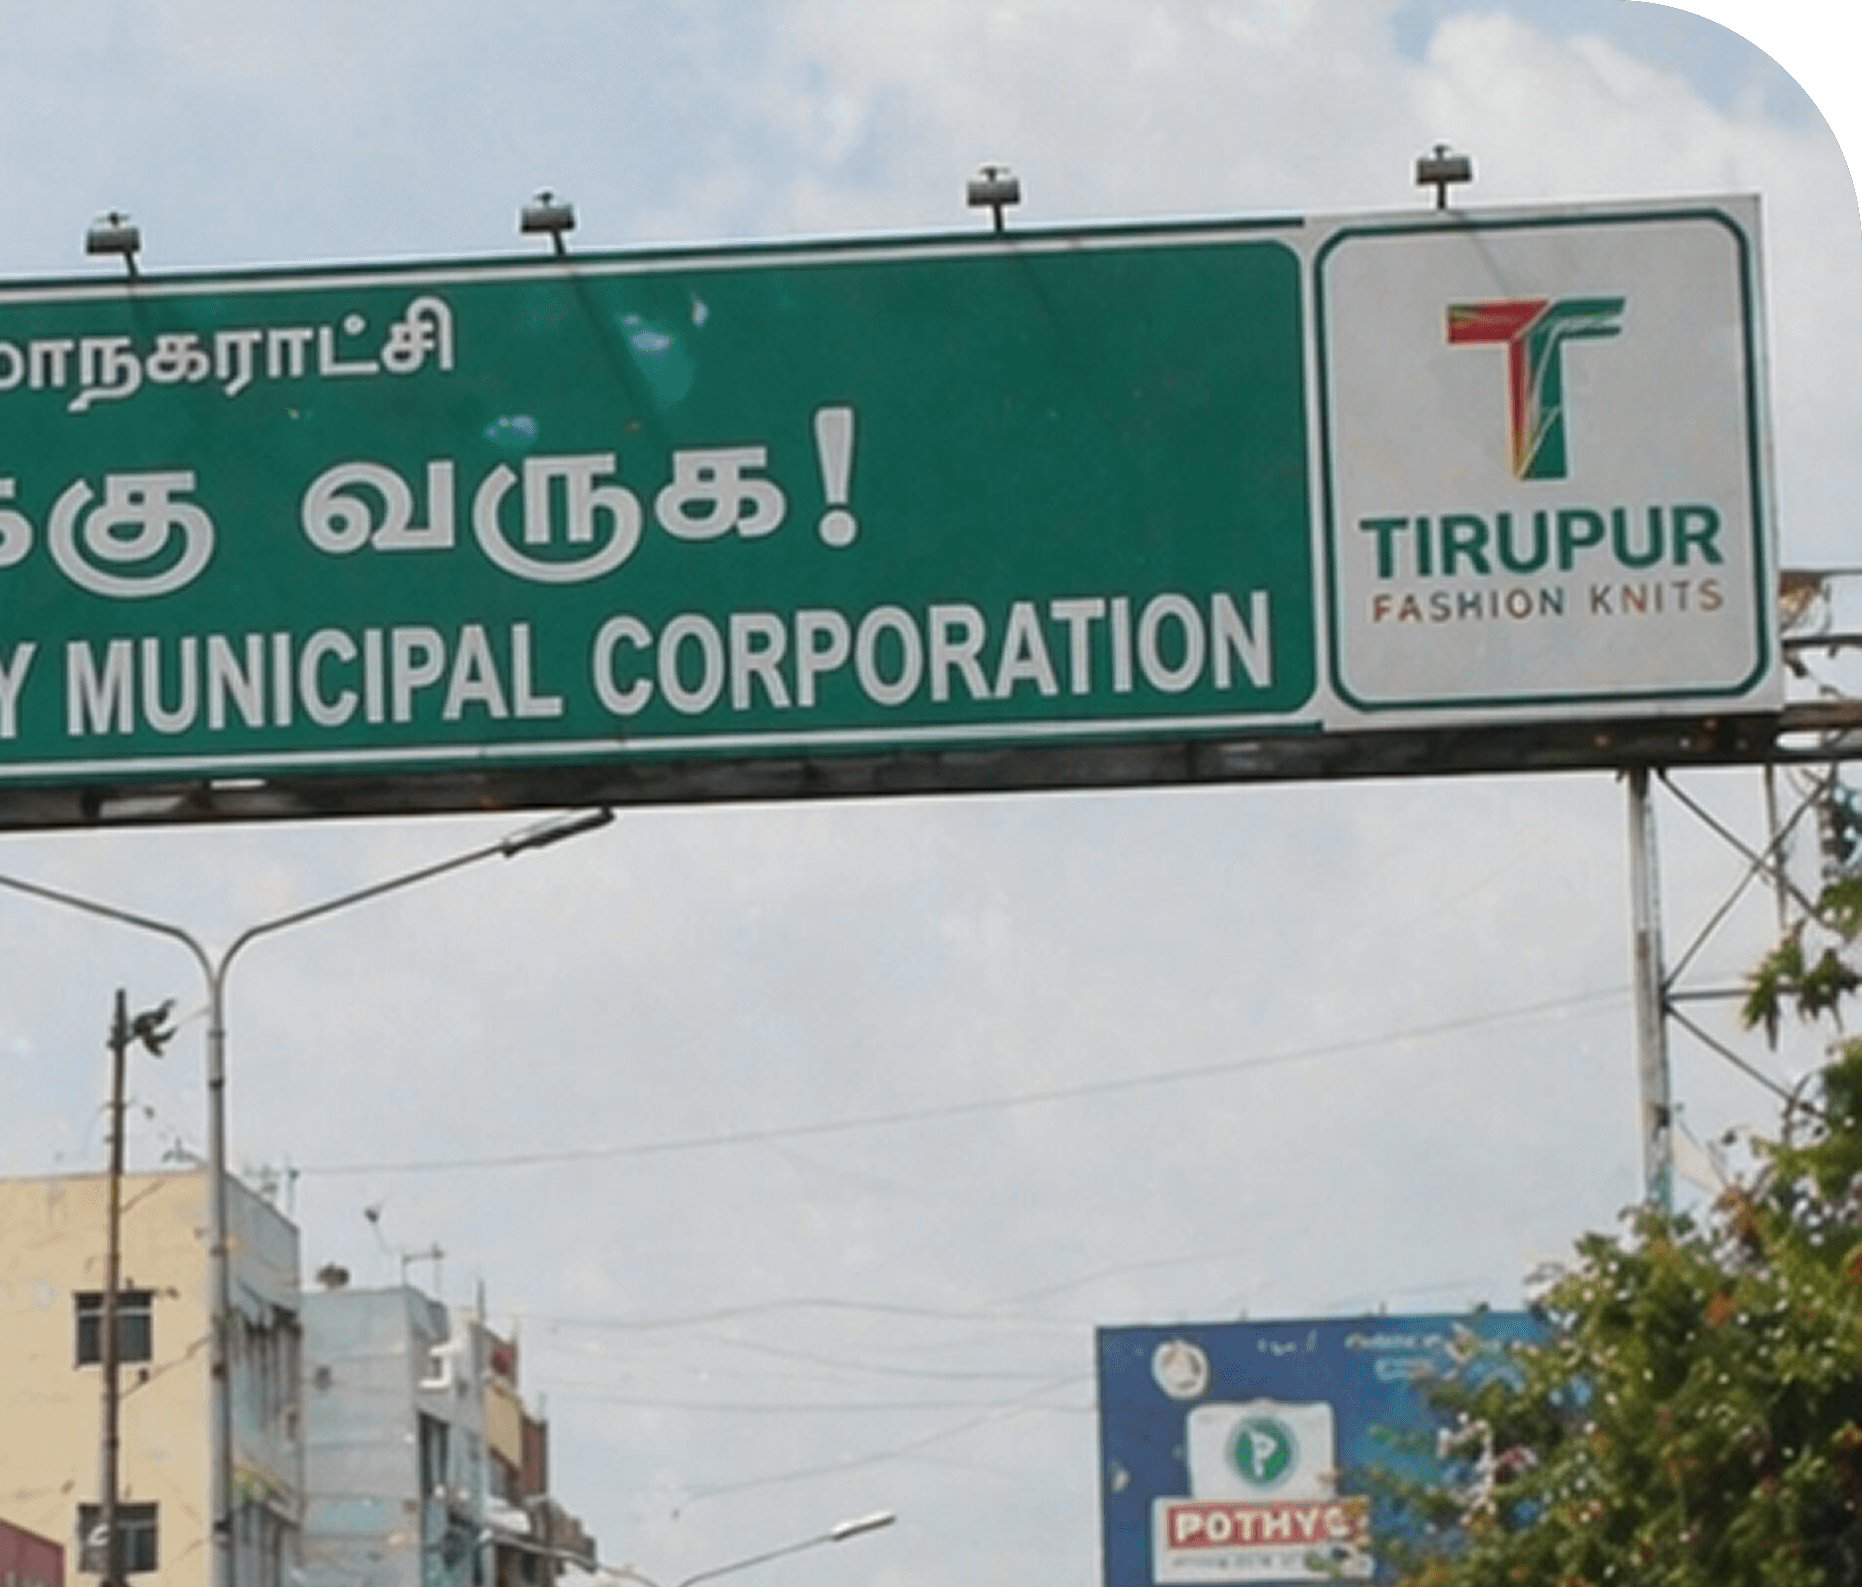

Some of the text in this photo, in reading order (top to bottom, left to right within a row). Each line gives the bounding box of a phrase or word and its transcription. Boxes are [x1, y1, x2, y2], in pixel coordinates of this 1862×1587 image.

[300, 405, 858, 584] வருக!
[1358, 503, 1725, 581] TIRUPUR
[1371, 579, 1725, 623] FASHION KNITS
[65, 622, 564, 737] MUNICIPAL
[592, 589, 1272, 717] CORPORATION
